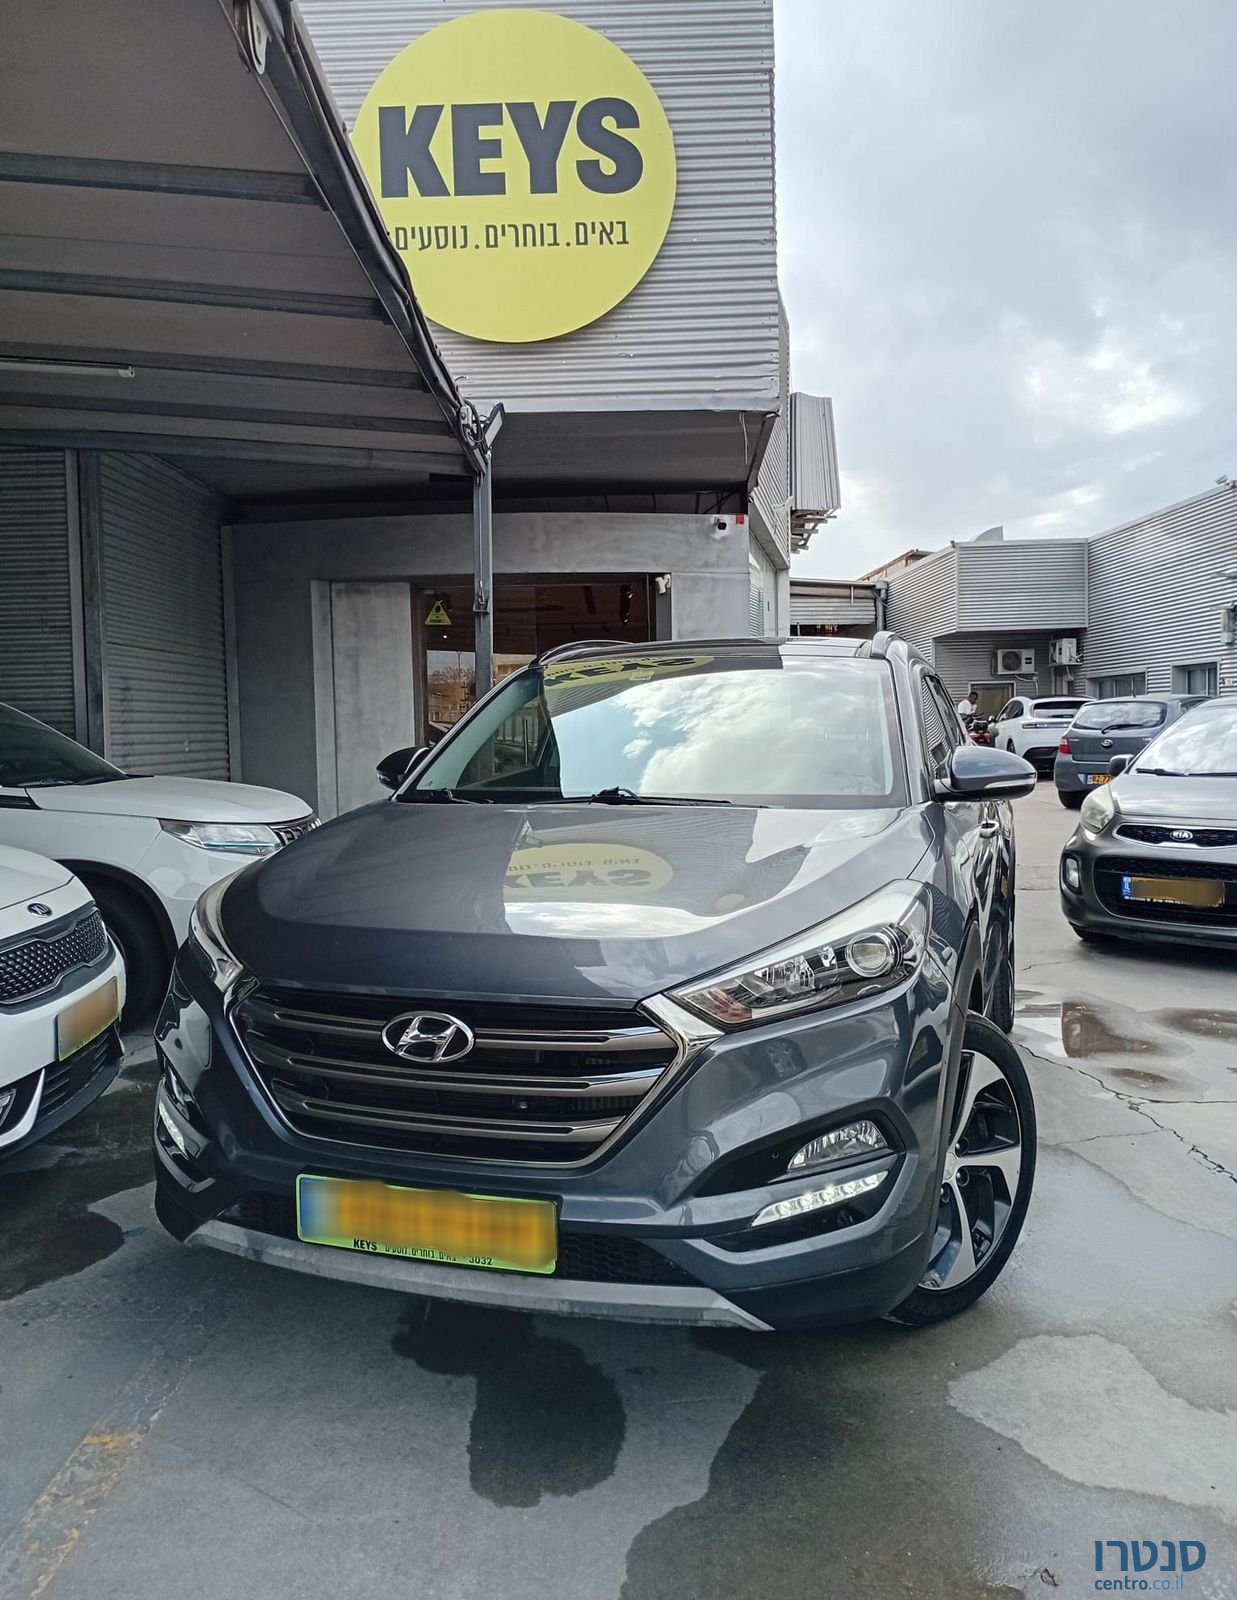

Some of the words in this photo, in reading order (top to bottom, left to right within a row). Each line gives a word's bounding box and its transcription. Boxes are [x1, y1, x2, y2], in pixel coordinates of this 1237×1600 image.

[378, 97, 644, 198] KEYS
[353, 1238, 378, 1252] KEYS
[469, 1256, 493, 1266] 3032
